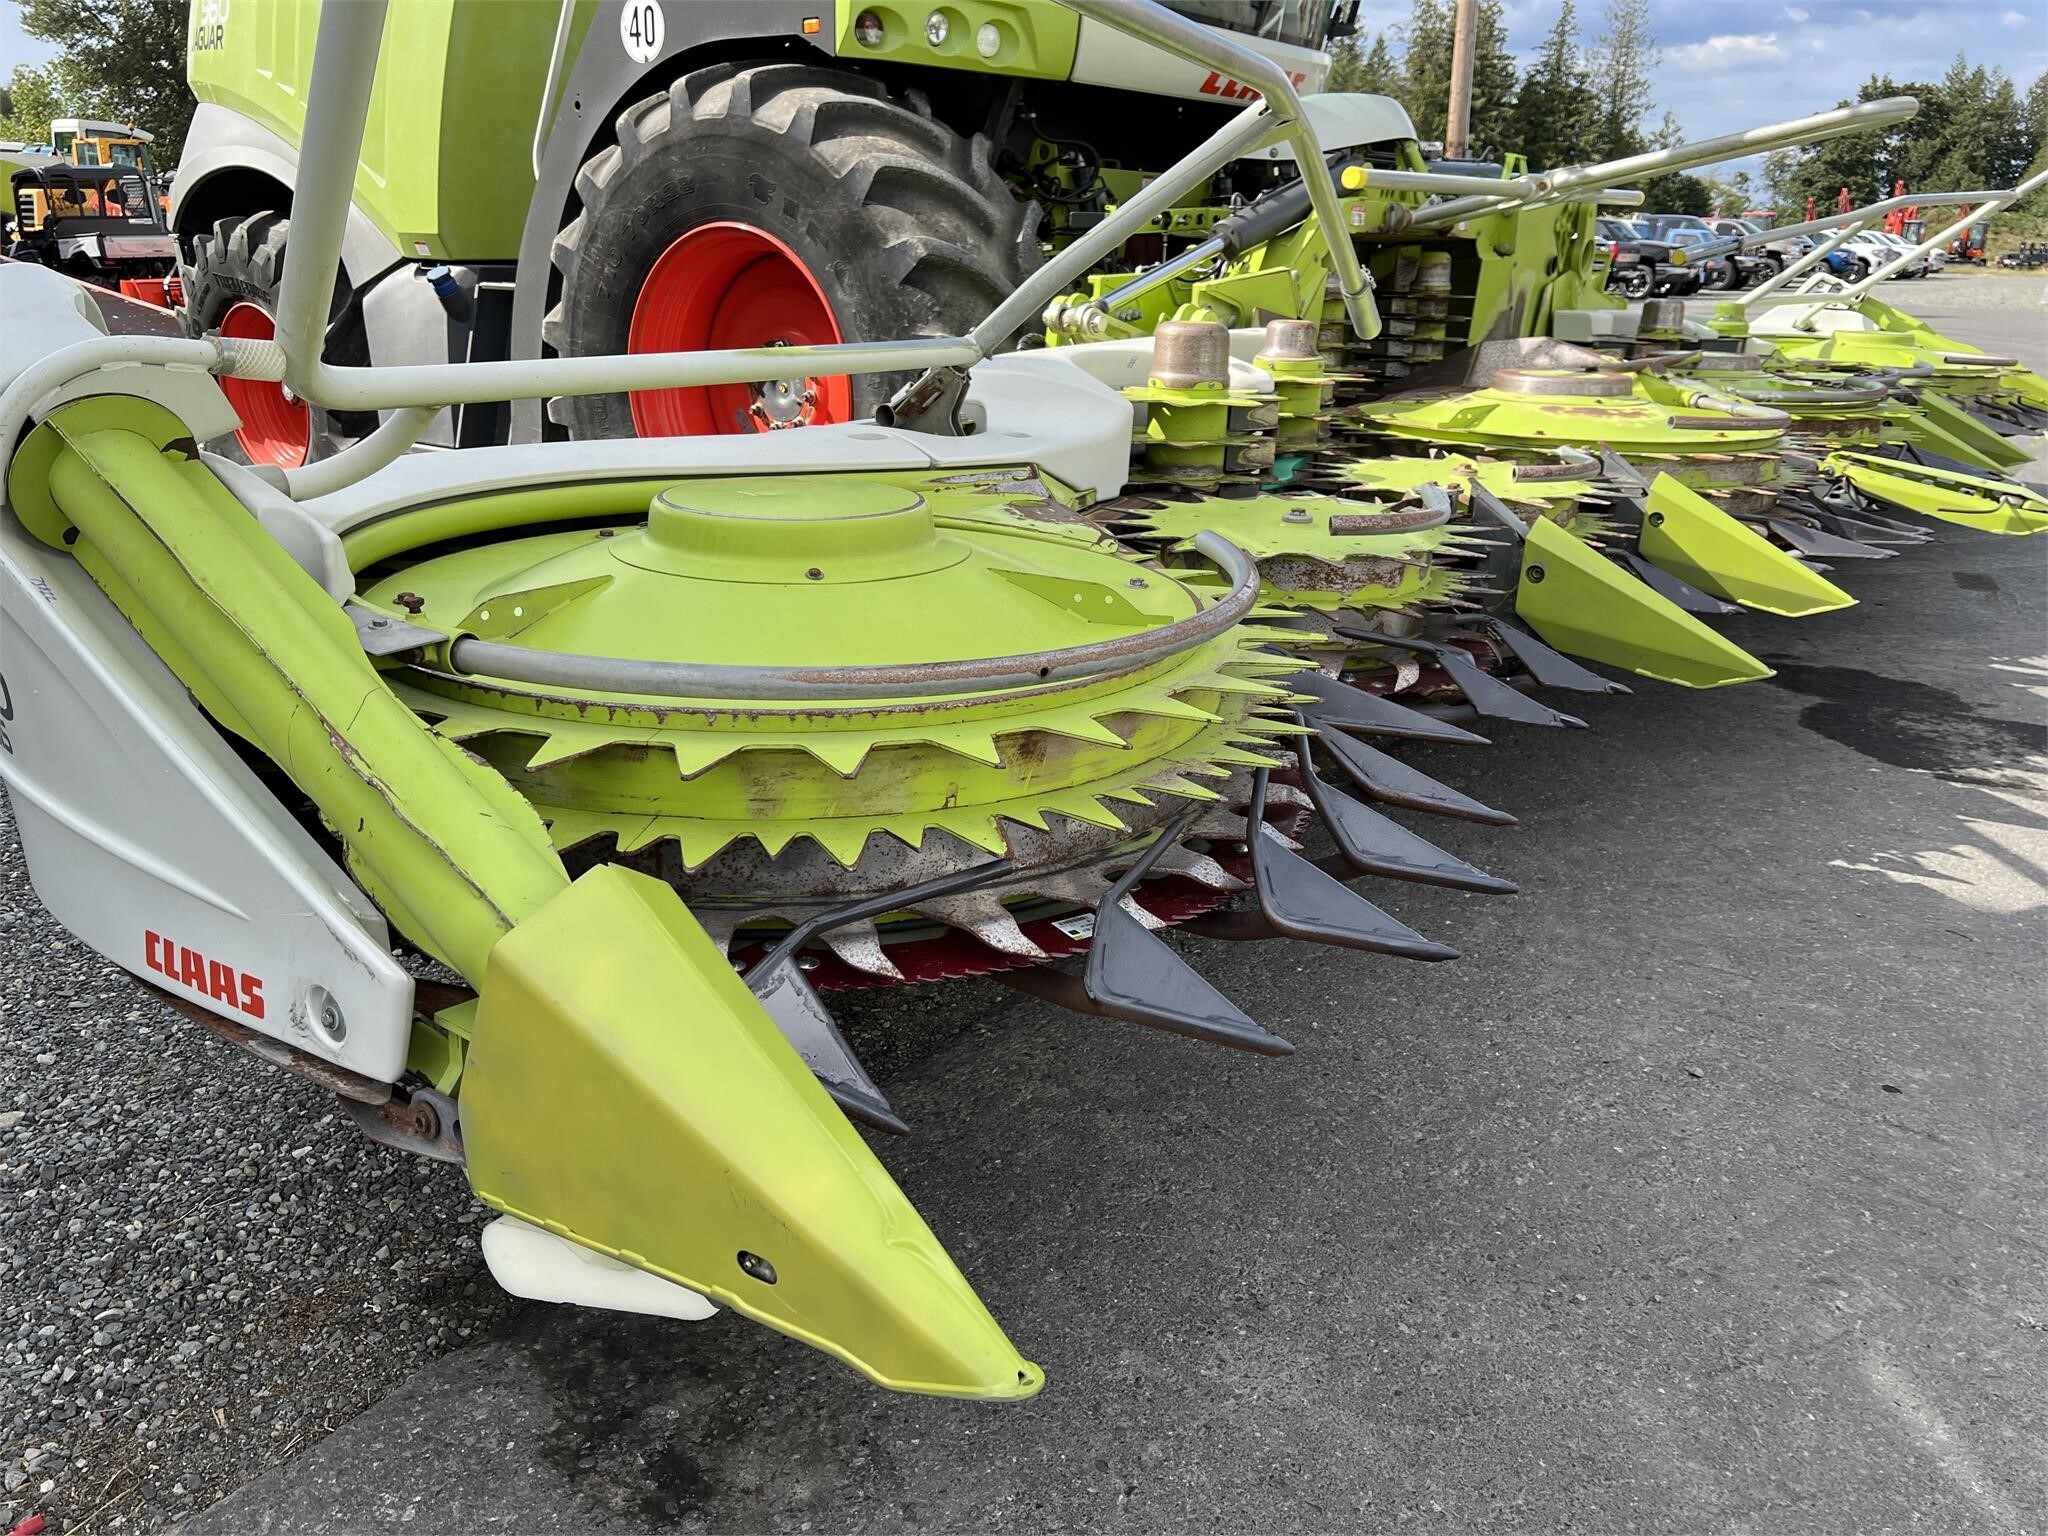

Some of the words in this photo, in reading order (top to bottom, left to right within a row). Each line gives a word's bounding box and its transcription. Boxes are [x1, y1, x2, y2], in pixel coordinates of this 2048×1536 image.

[191, 24, 224, 51] AGUAR
[630, 5, 655, 48] 40
[145, 929, 265, 1020] CLAAS
